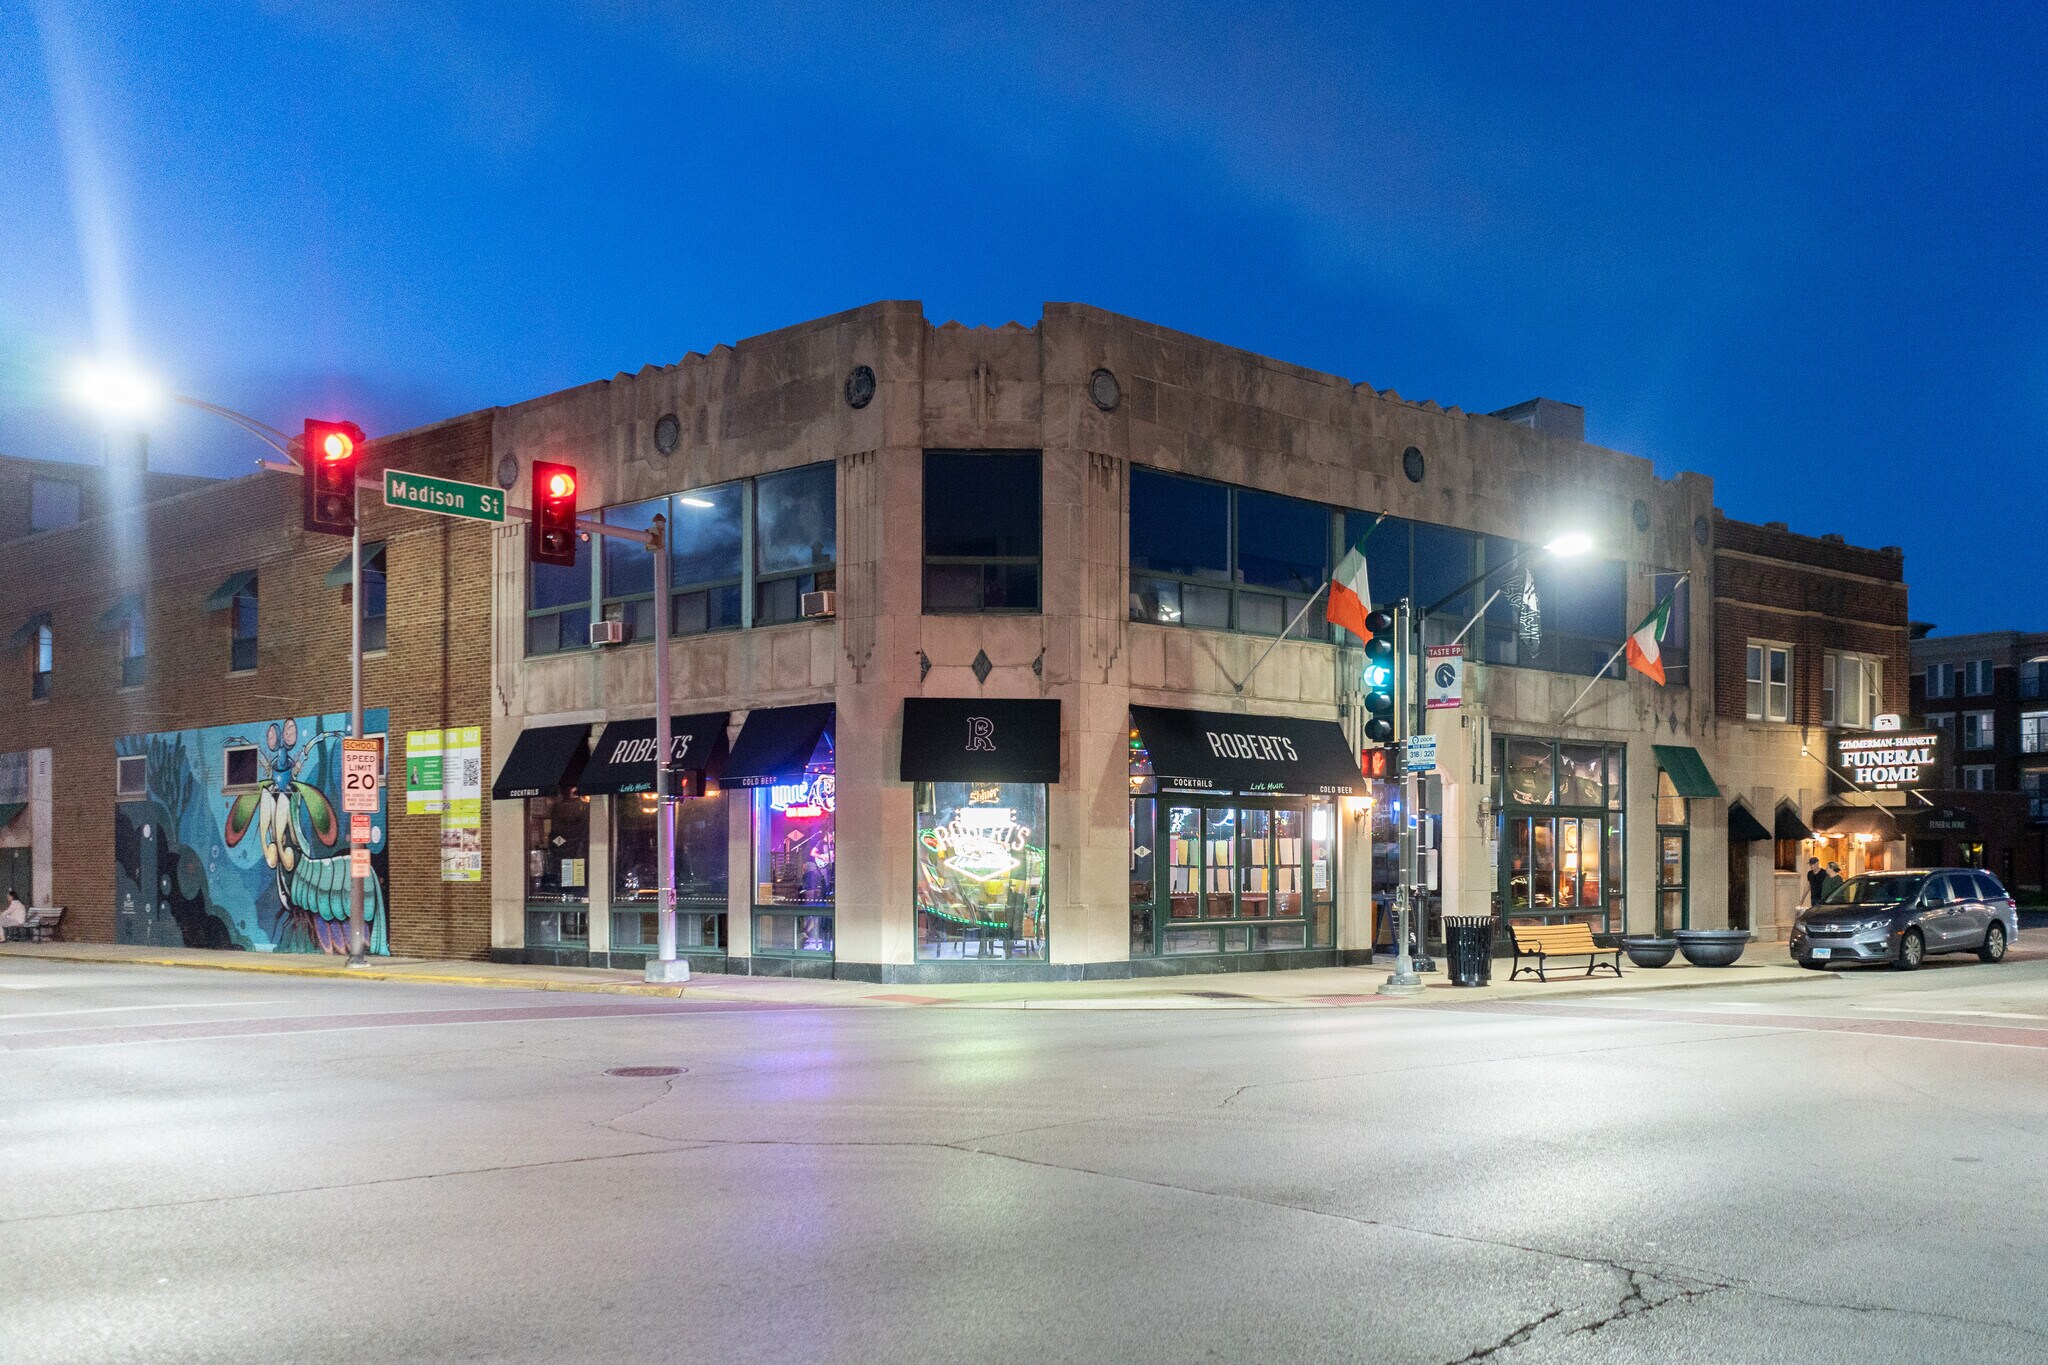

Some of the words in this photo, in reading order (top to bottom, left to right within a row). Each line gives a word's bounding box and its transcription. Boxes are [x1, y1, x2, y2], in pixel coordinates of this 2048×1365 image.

[392, 480, 464, 508] Madison
[480, 495, 499, 514] St
[965, 717, 996, 751] R
[345, 742, 377, 750] SCHOOL
[610, 735, 692, 764] ROBET'S
[1206, 732, 1298, 762] ROBERT'S
[1838, 735, 1937, 750] ZIMMERMAN-HARNETT
[1841, 748, 1935, 767] FUNERAL
[347, 774, 374, 790] 20
[742, 778, 759, 786] COLD
[1855, 766, 1919, 783] HOME
[1173, 778, 1213, 788] COCKTAILS
[1338, 786, 1352, 794] BEER
[510, 788, 539, 797] COCKTAILS
